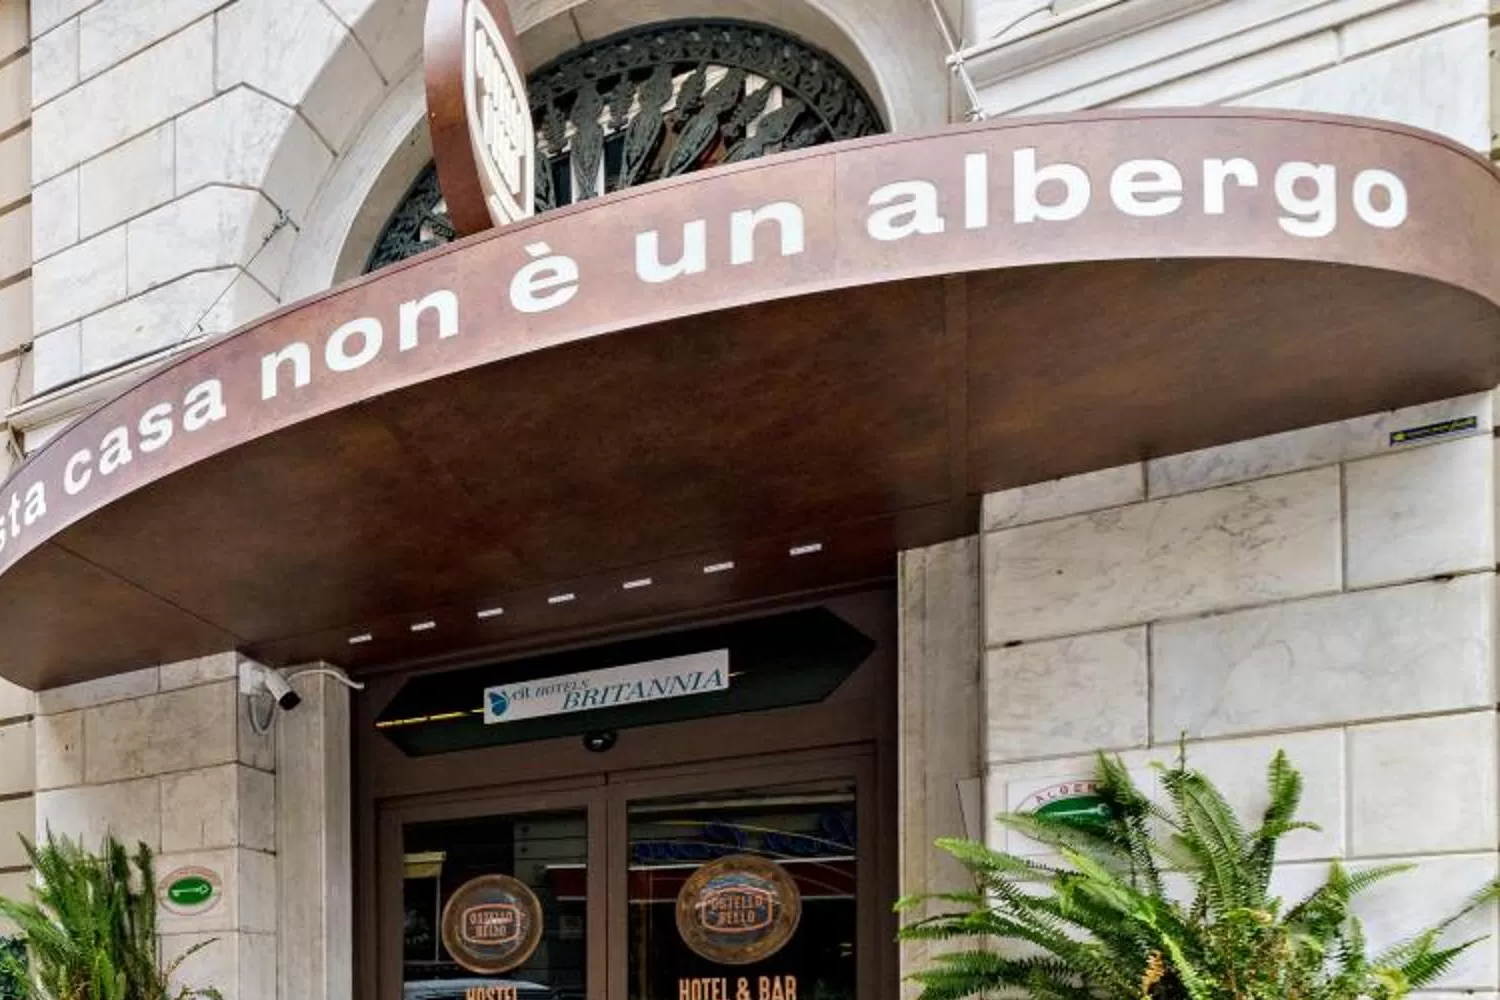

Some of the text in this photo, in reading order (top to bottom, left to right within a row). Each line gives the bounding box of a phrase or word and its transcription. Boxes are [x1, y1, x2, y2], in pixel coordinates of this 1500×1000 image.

[63, 374, 227, 496] casa
[260, 287, 460, 400] non
[509, 241, 580, 313] è
[635, 201, 805, 283] un
[867, 147, 1408, 240] albergo
[563, 669, 723, 710] BRITANNIA
